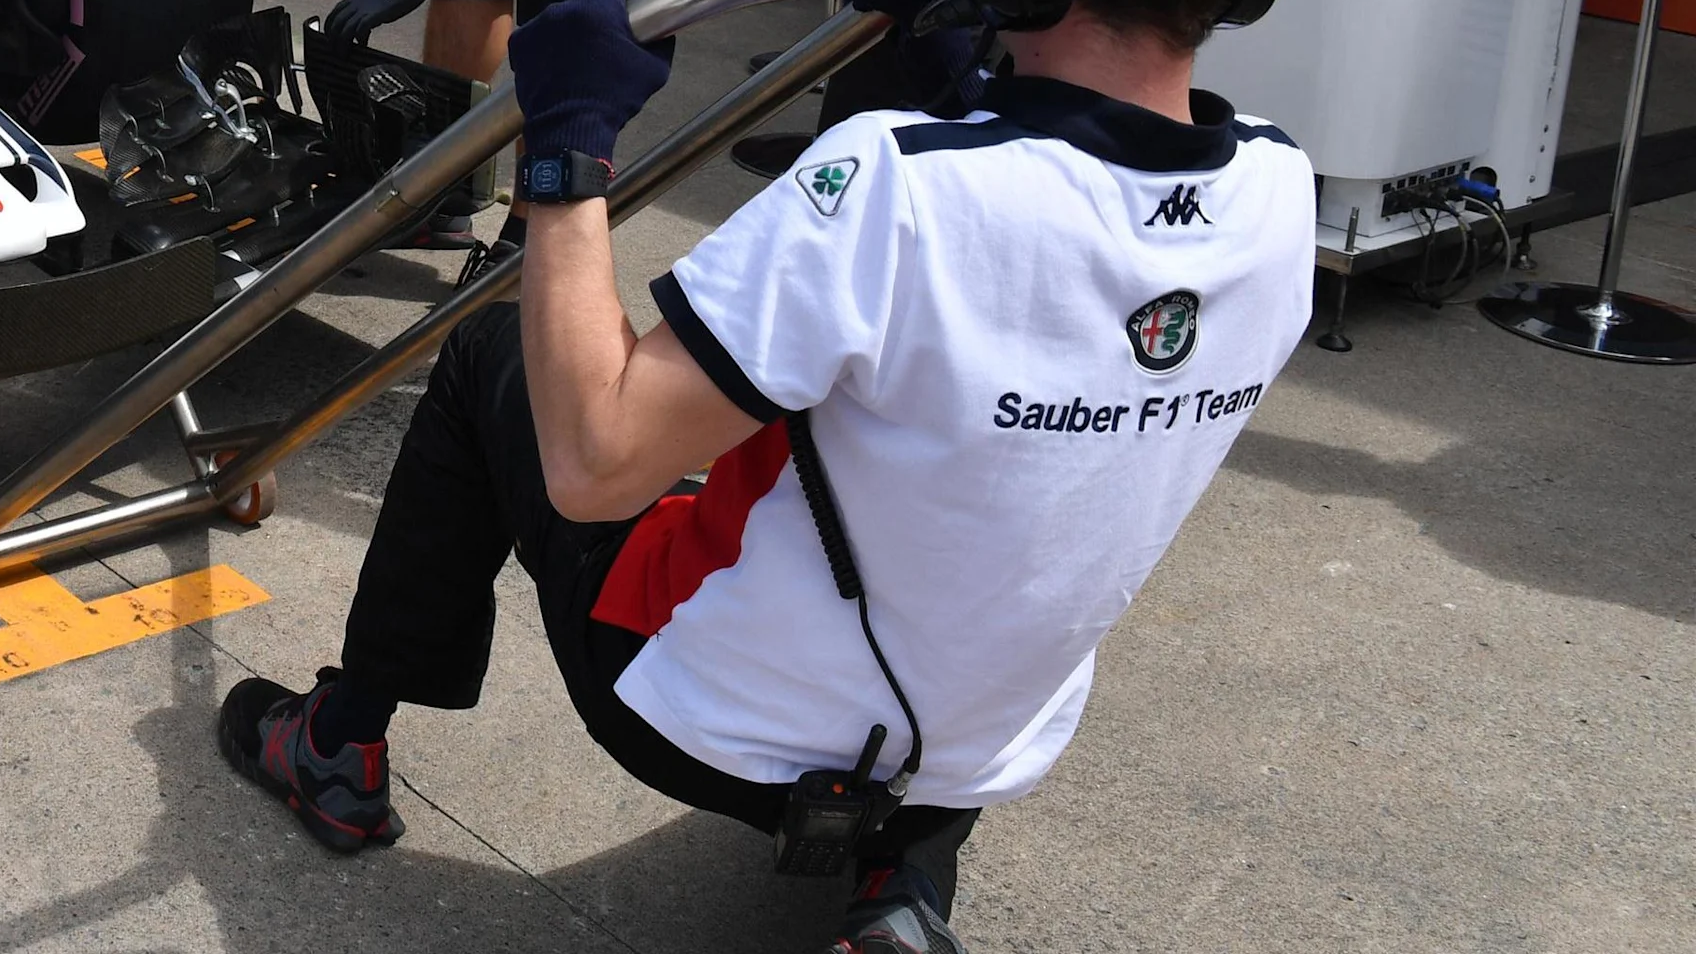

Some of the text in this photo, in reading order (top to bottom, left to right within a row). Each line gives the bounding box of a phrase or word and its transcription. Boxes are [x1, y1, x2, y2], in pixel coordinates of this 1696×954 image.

[1130, 299, 1165, 333] ALFA
[993, 391, 1130, 433] Sauber
[1194, 382, 1263, 424] Team
